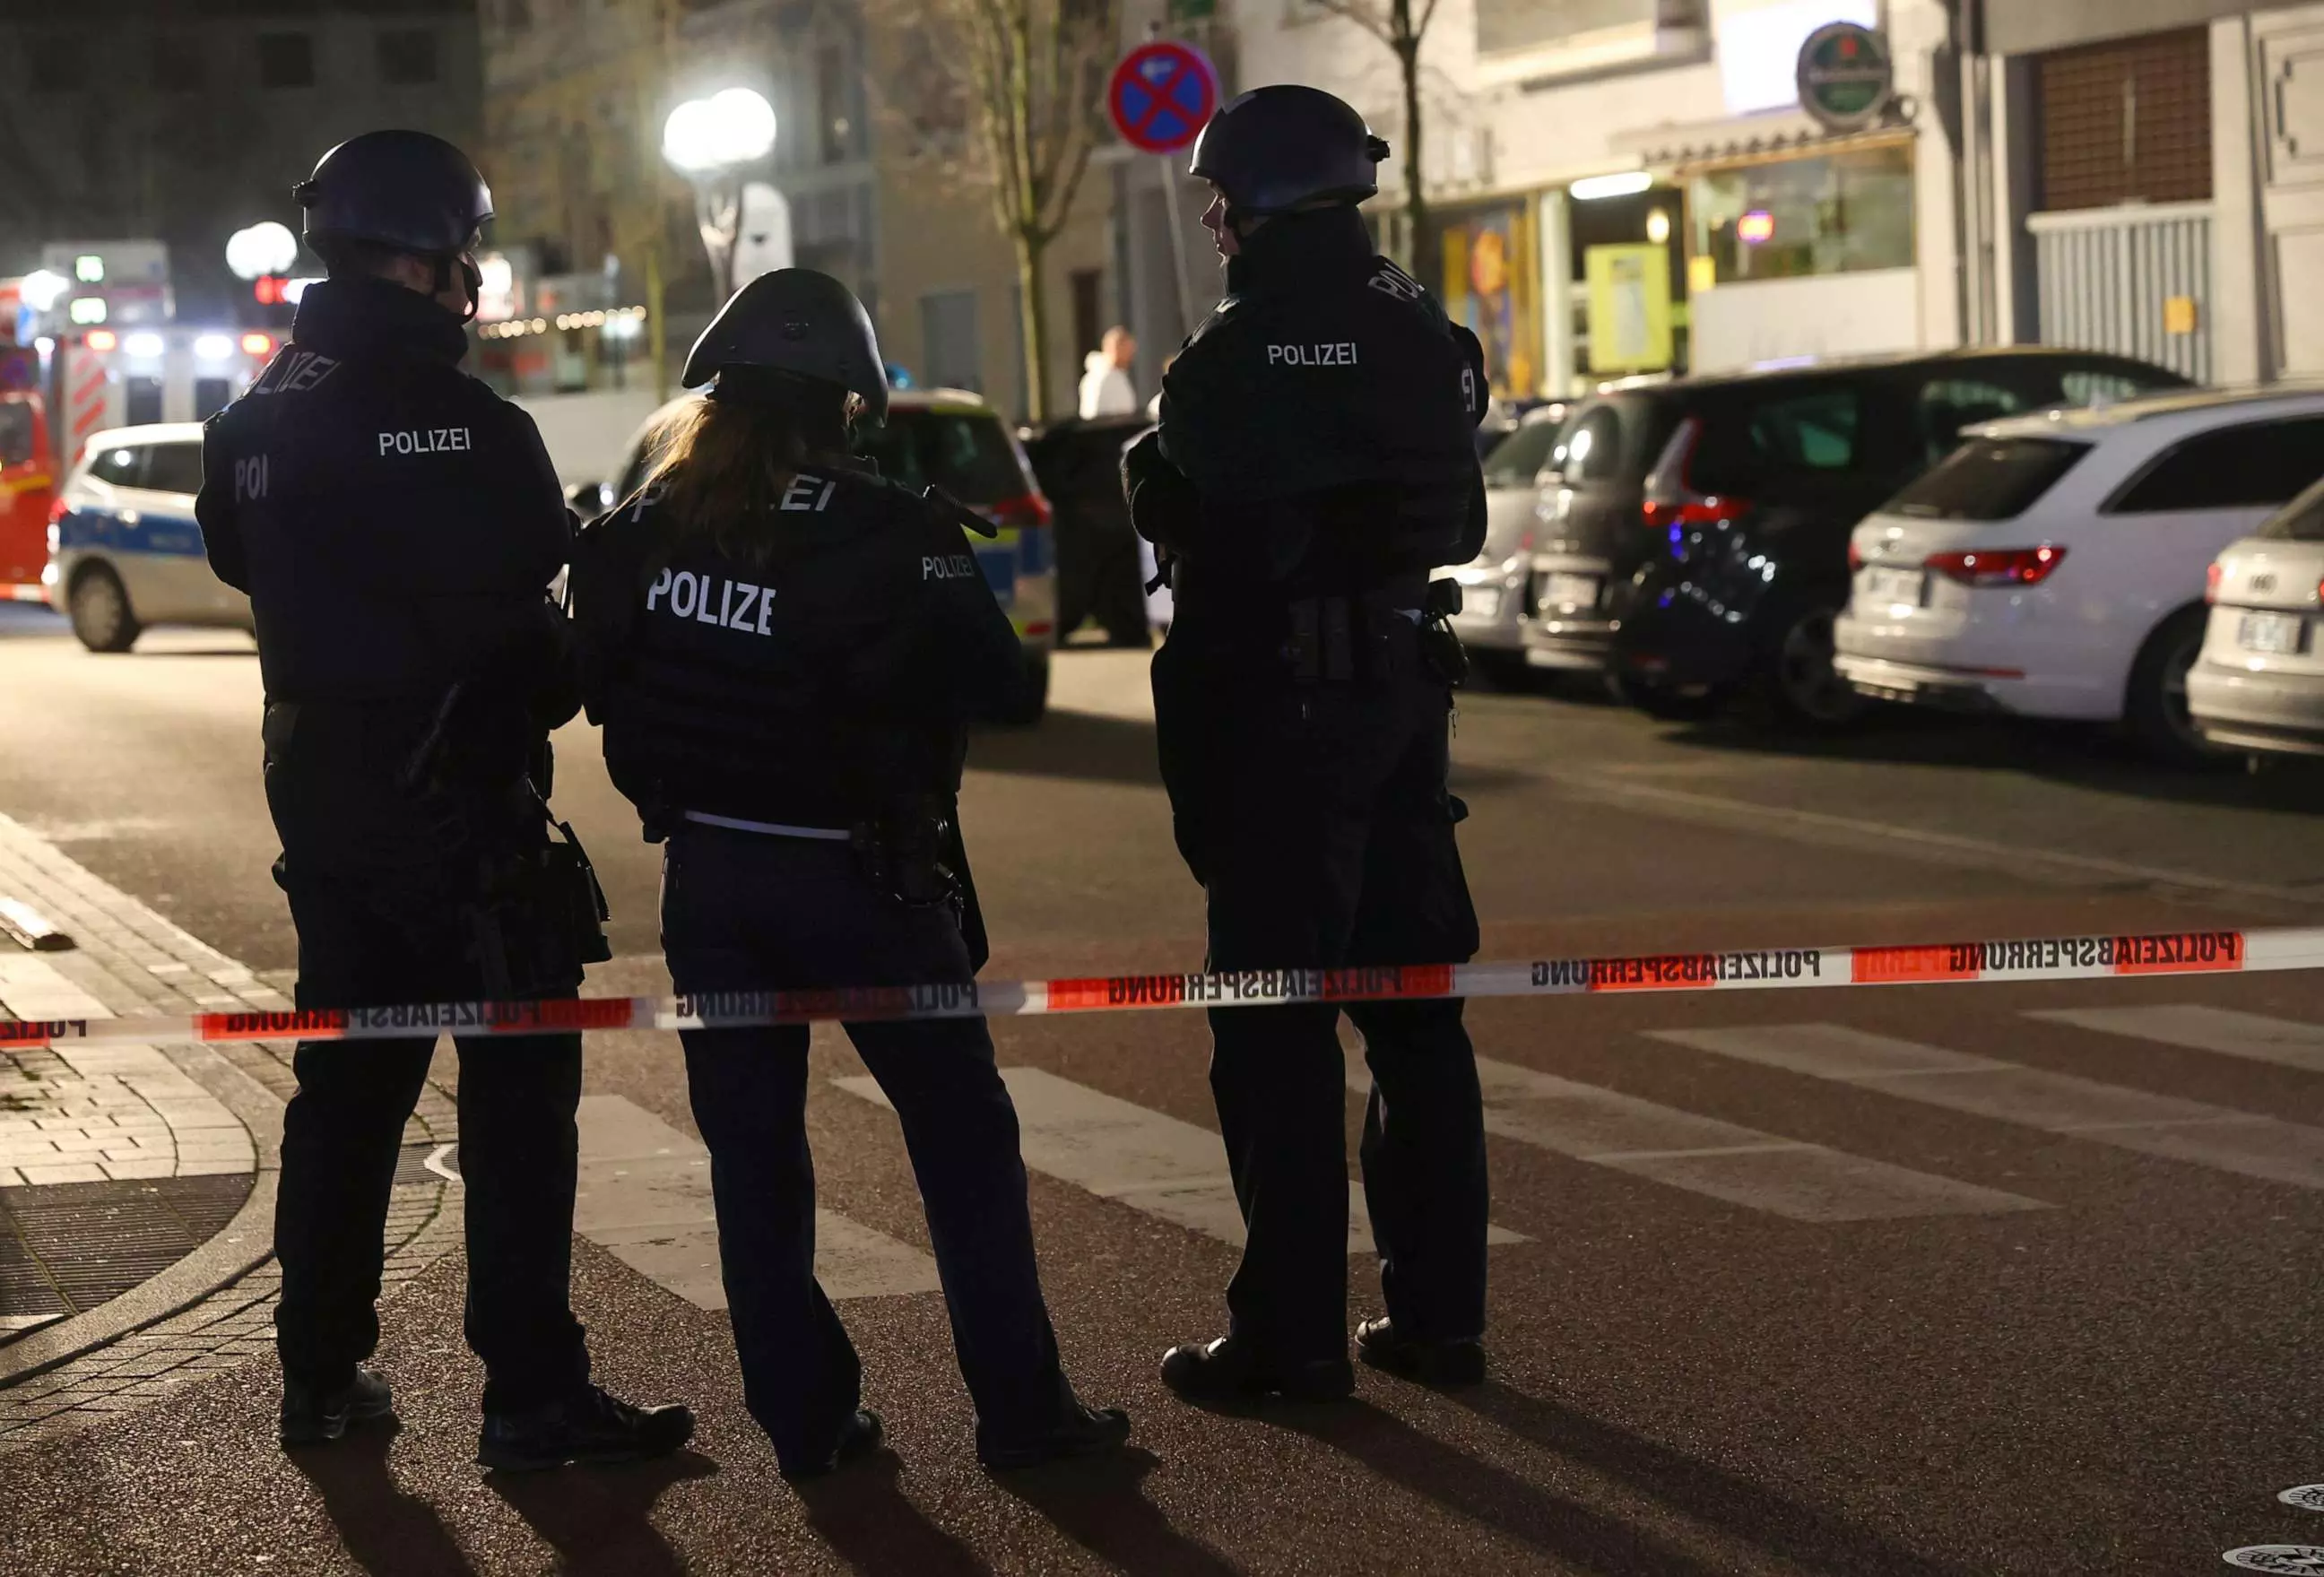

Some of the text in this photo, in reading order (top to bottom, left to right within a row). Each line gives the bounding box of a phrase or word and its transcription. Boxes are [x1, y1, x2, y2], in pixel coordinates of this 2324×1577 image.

[1267, 342, 1357, 365] POLIZEI
[378, 428, 471, 455] POLIZEI
[922, 555, 976, 581] POLIZEI
[646, 567, 777, 637] POLIZE
